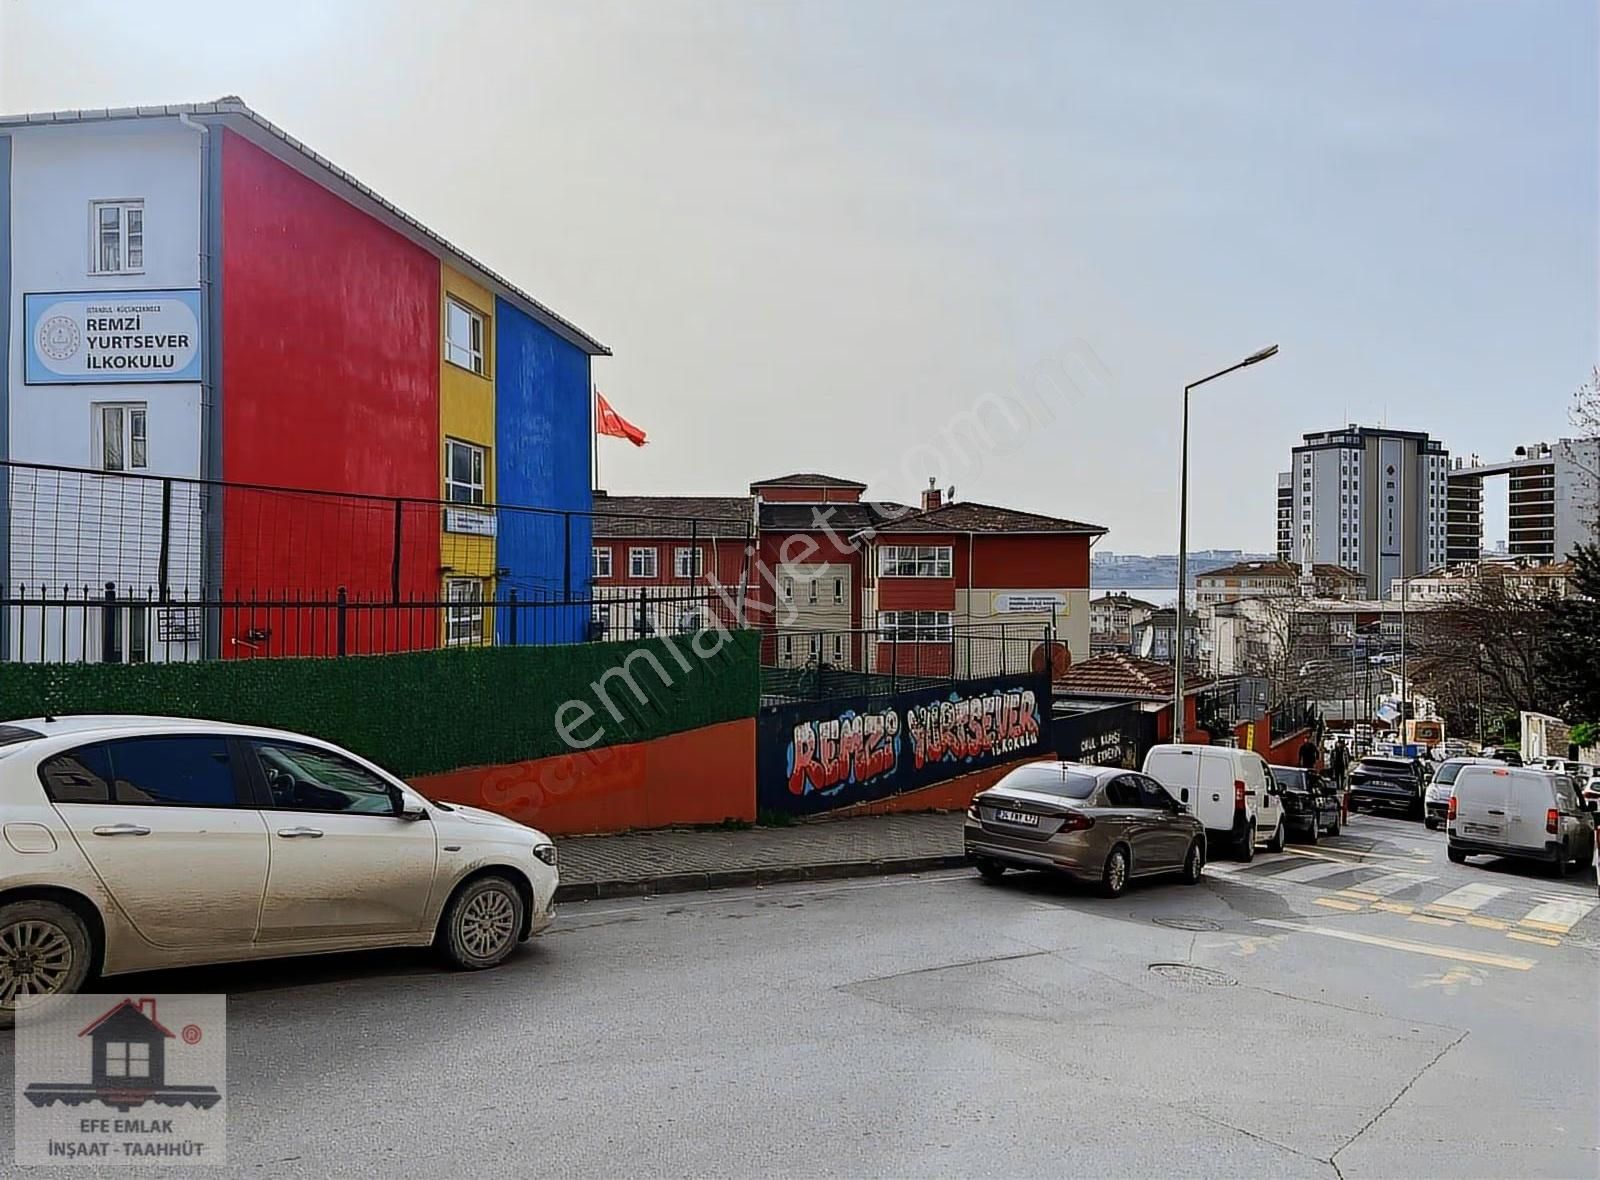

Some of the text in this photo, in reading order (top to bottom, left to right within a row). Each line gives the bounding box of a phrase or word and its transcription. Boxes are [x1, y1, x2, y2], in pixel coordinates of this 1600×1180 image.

[86, 314, 140, 331] REMZİ
[86, 335, 189, 349] YURTSEVER
[86, 353, 175, 369] İLKOKULU
[906, 689, 1039, 769] YURTSEVER
